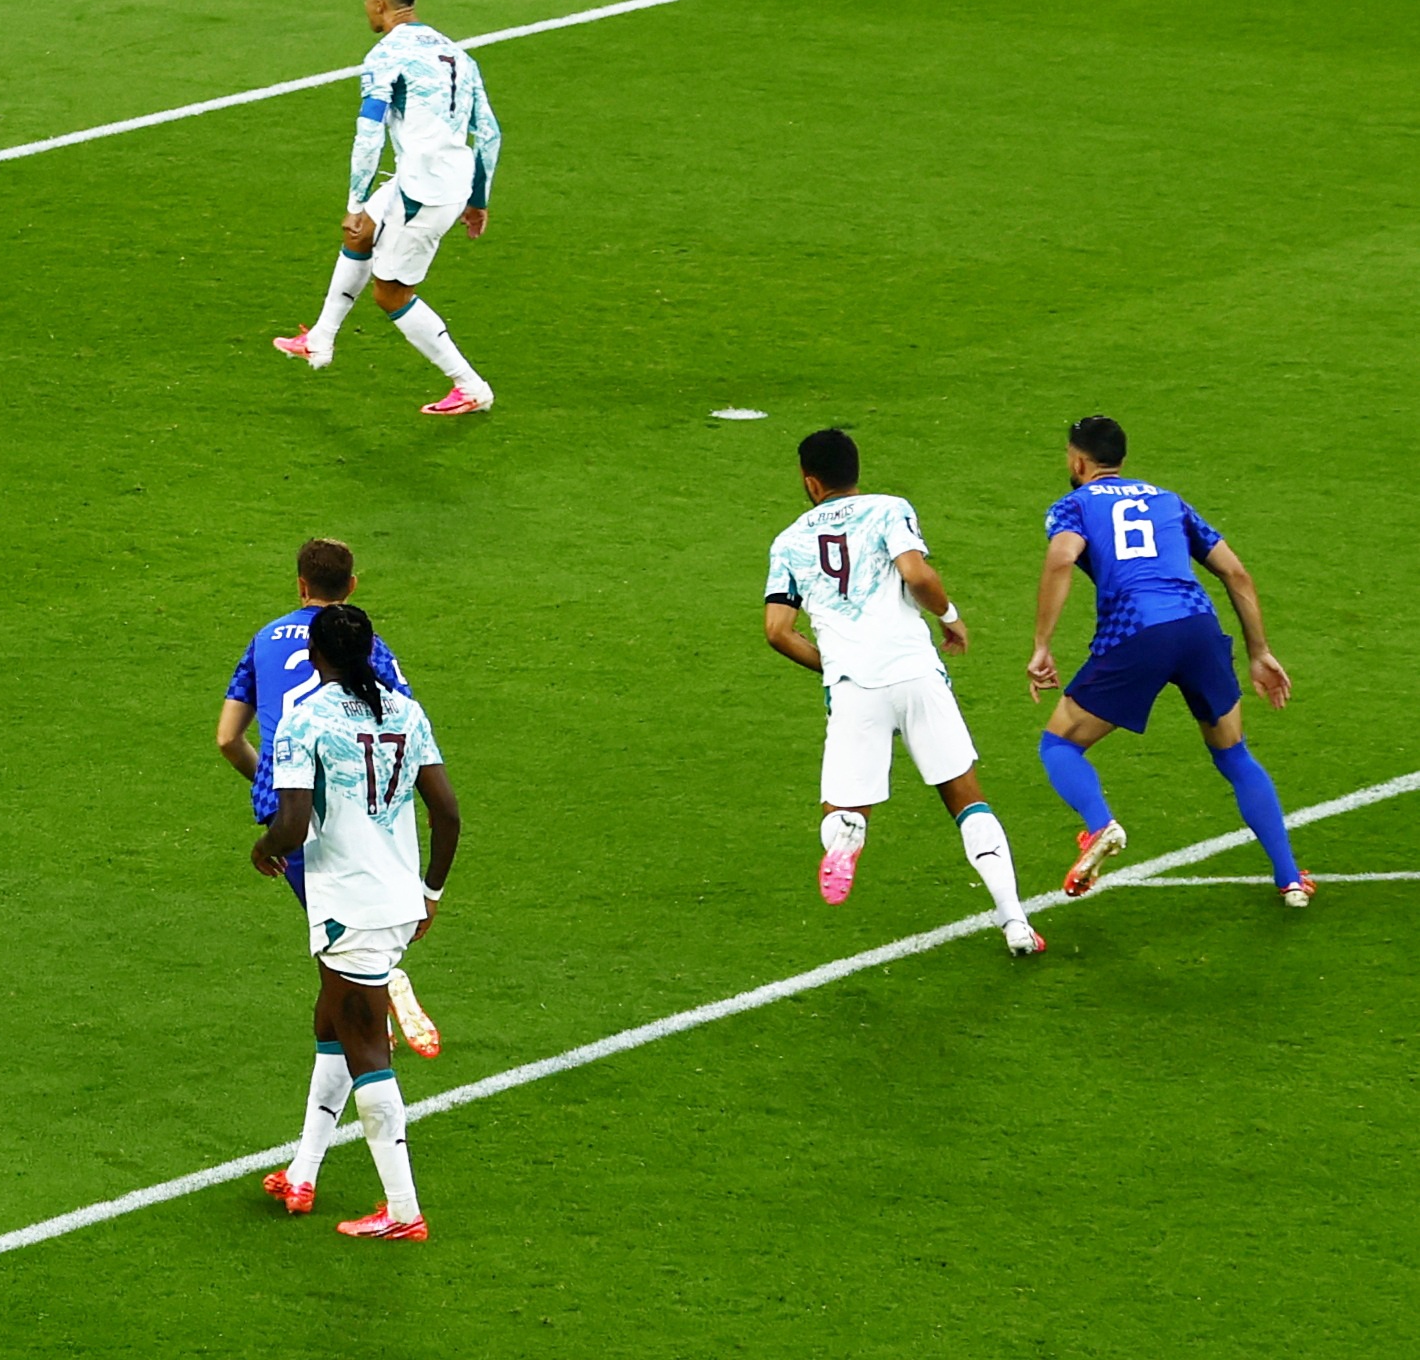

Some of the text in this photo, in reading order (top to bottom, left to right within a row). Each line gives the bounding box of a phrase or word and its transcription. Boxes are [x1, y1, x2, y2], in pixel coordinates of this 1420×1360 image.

[1111, 498, 1158, 560] 6
[818, 532, 851, 600] 9
[282, 648, 321, 716] 2
[356, 733, 407, 815] 17
